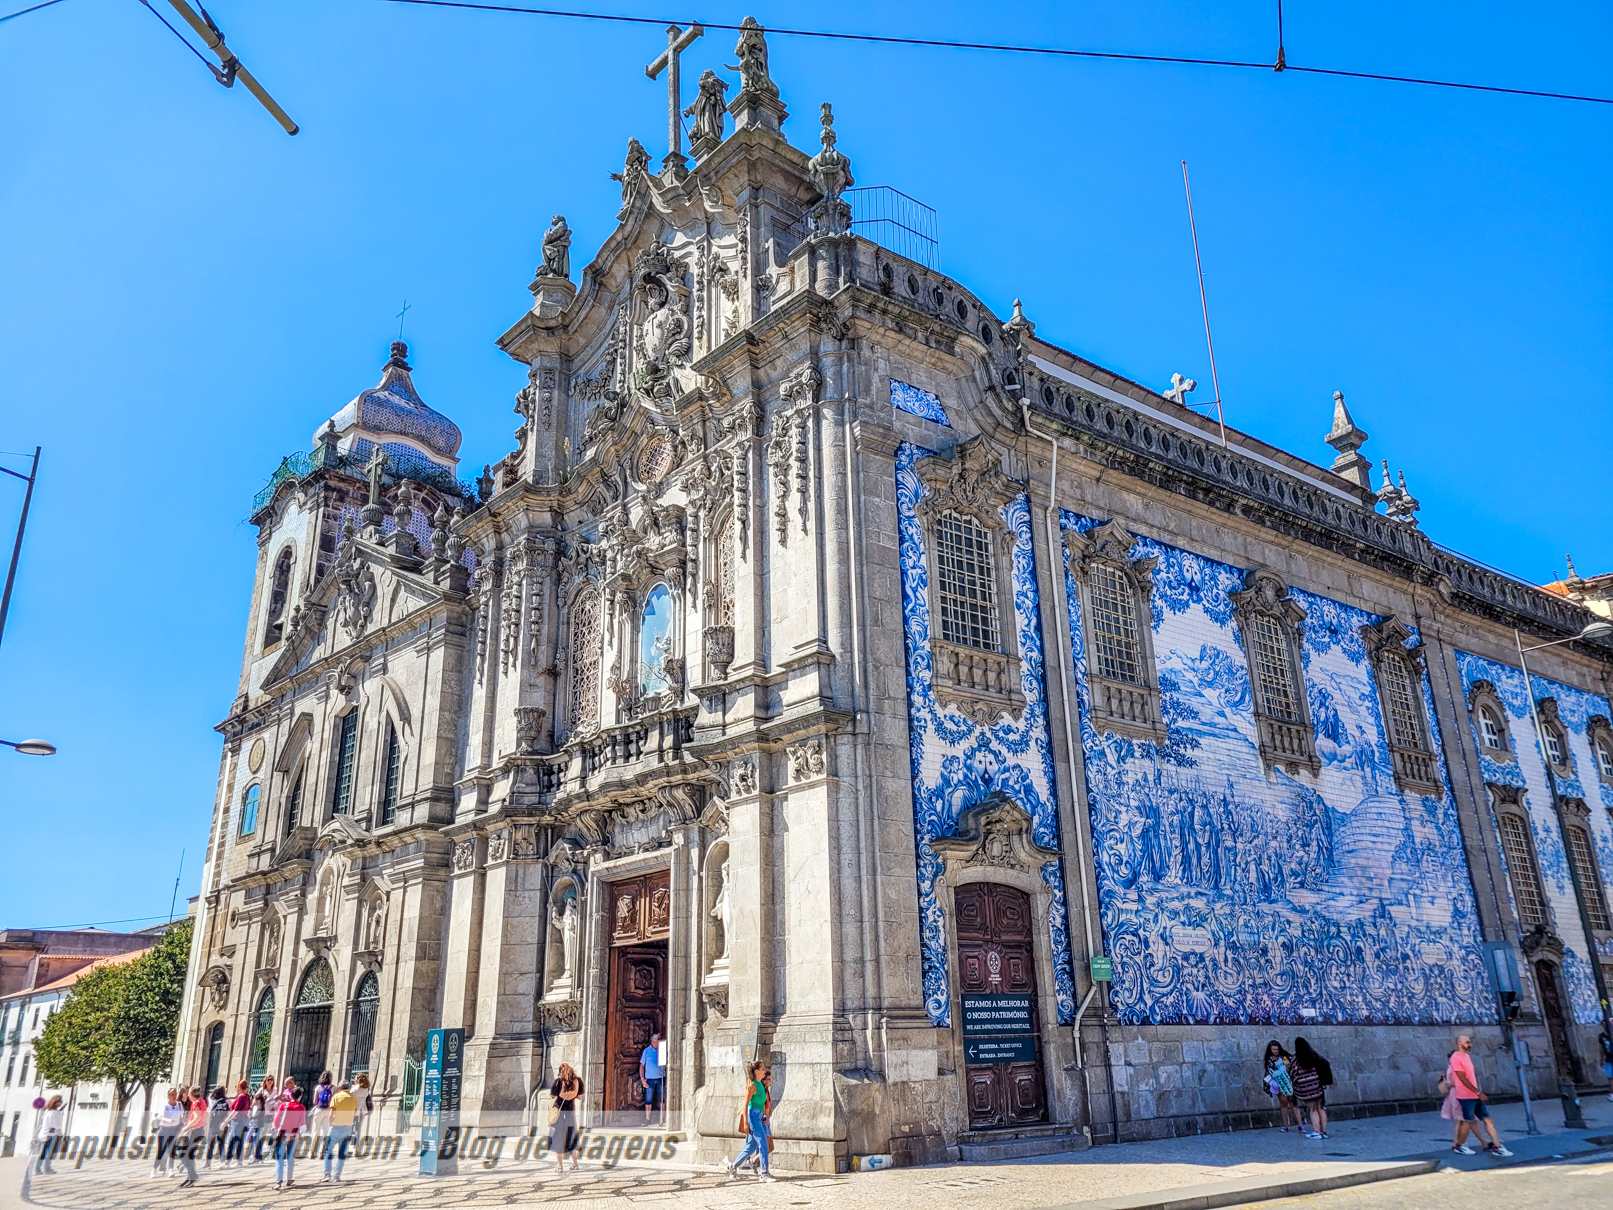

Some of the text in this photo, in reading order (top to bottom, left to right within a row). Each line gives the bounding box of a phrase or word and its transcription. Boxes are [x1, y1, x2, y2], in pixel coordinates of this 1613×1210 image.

[965, 1000, 1030, 1008] ESTAMOS A MELHORAR
[972, 1011, 991, 1019] NOSSO
